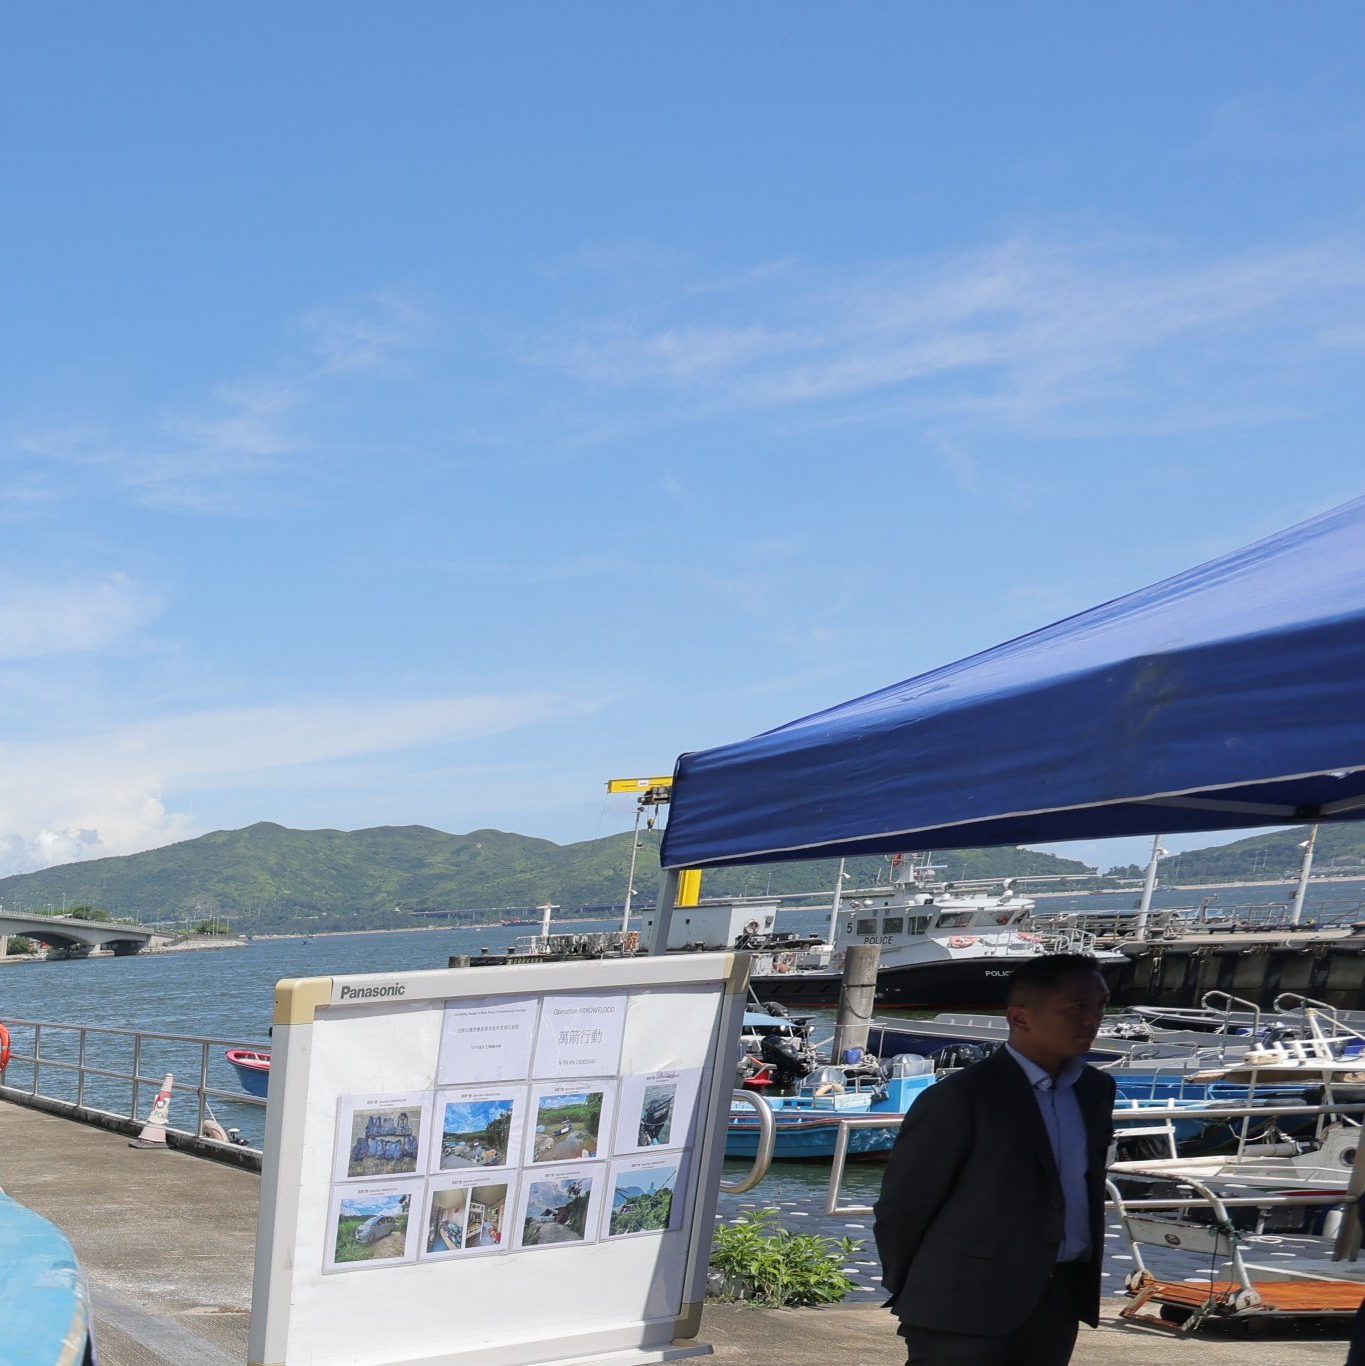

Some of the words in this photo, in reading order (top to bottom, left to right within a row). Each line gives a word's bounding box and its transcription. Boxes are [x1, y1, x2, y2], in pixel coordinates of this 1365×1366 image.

[846, 922, 853, 934] 5
[863, 936, 894, 945] POLICE
[340, 982, 406, 999] Panasonic
[553, 1008, 578, 1016] Operation
[558, 1029, 603, 1045] 萬箭行動
